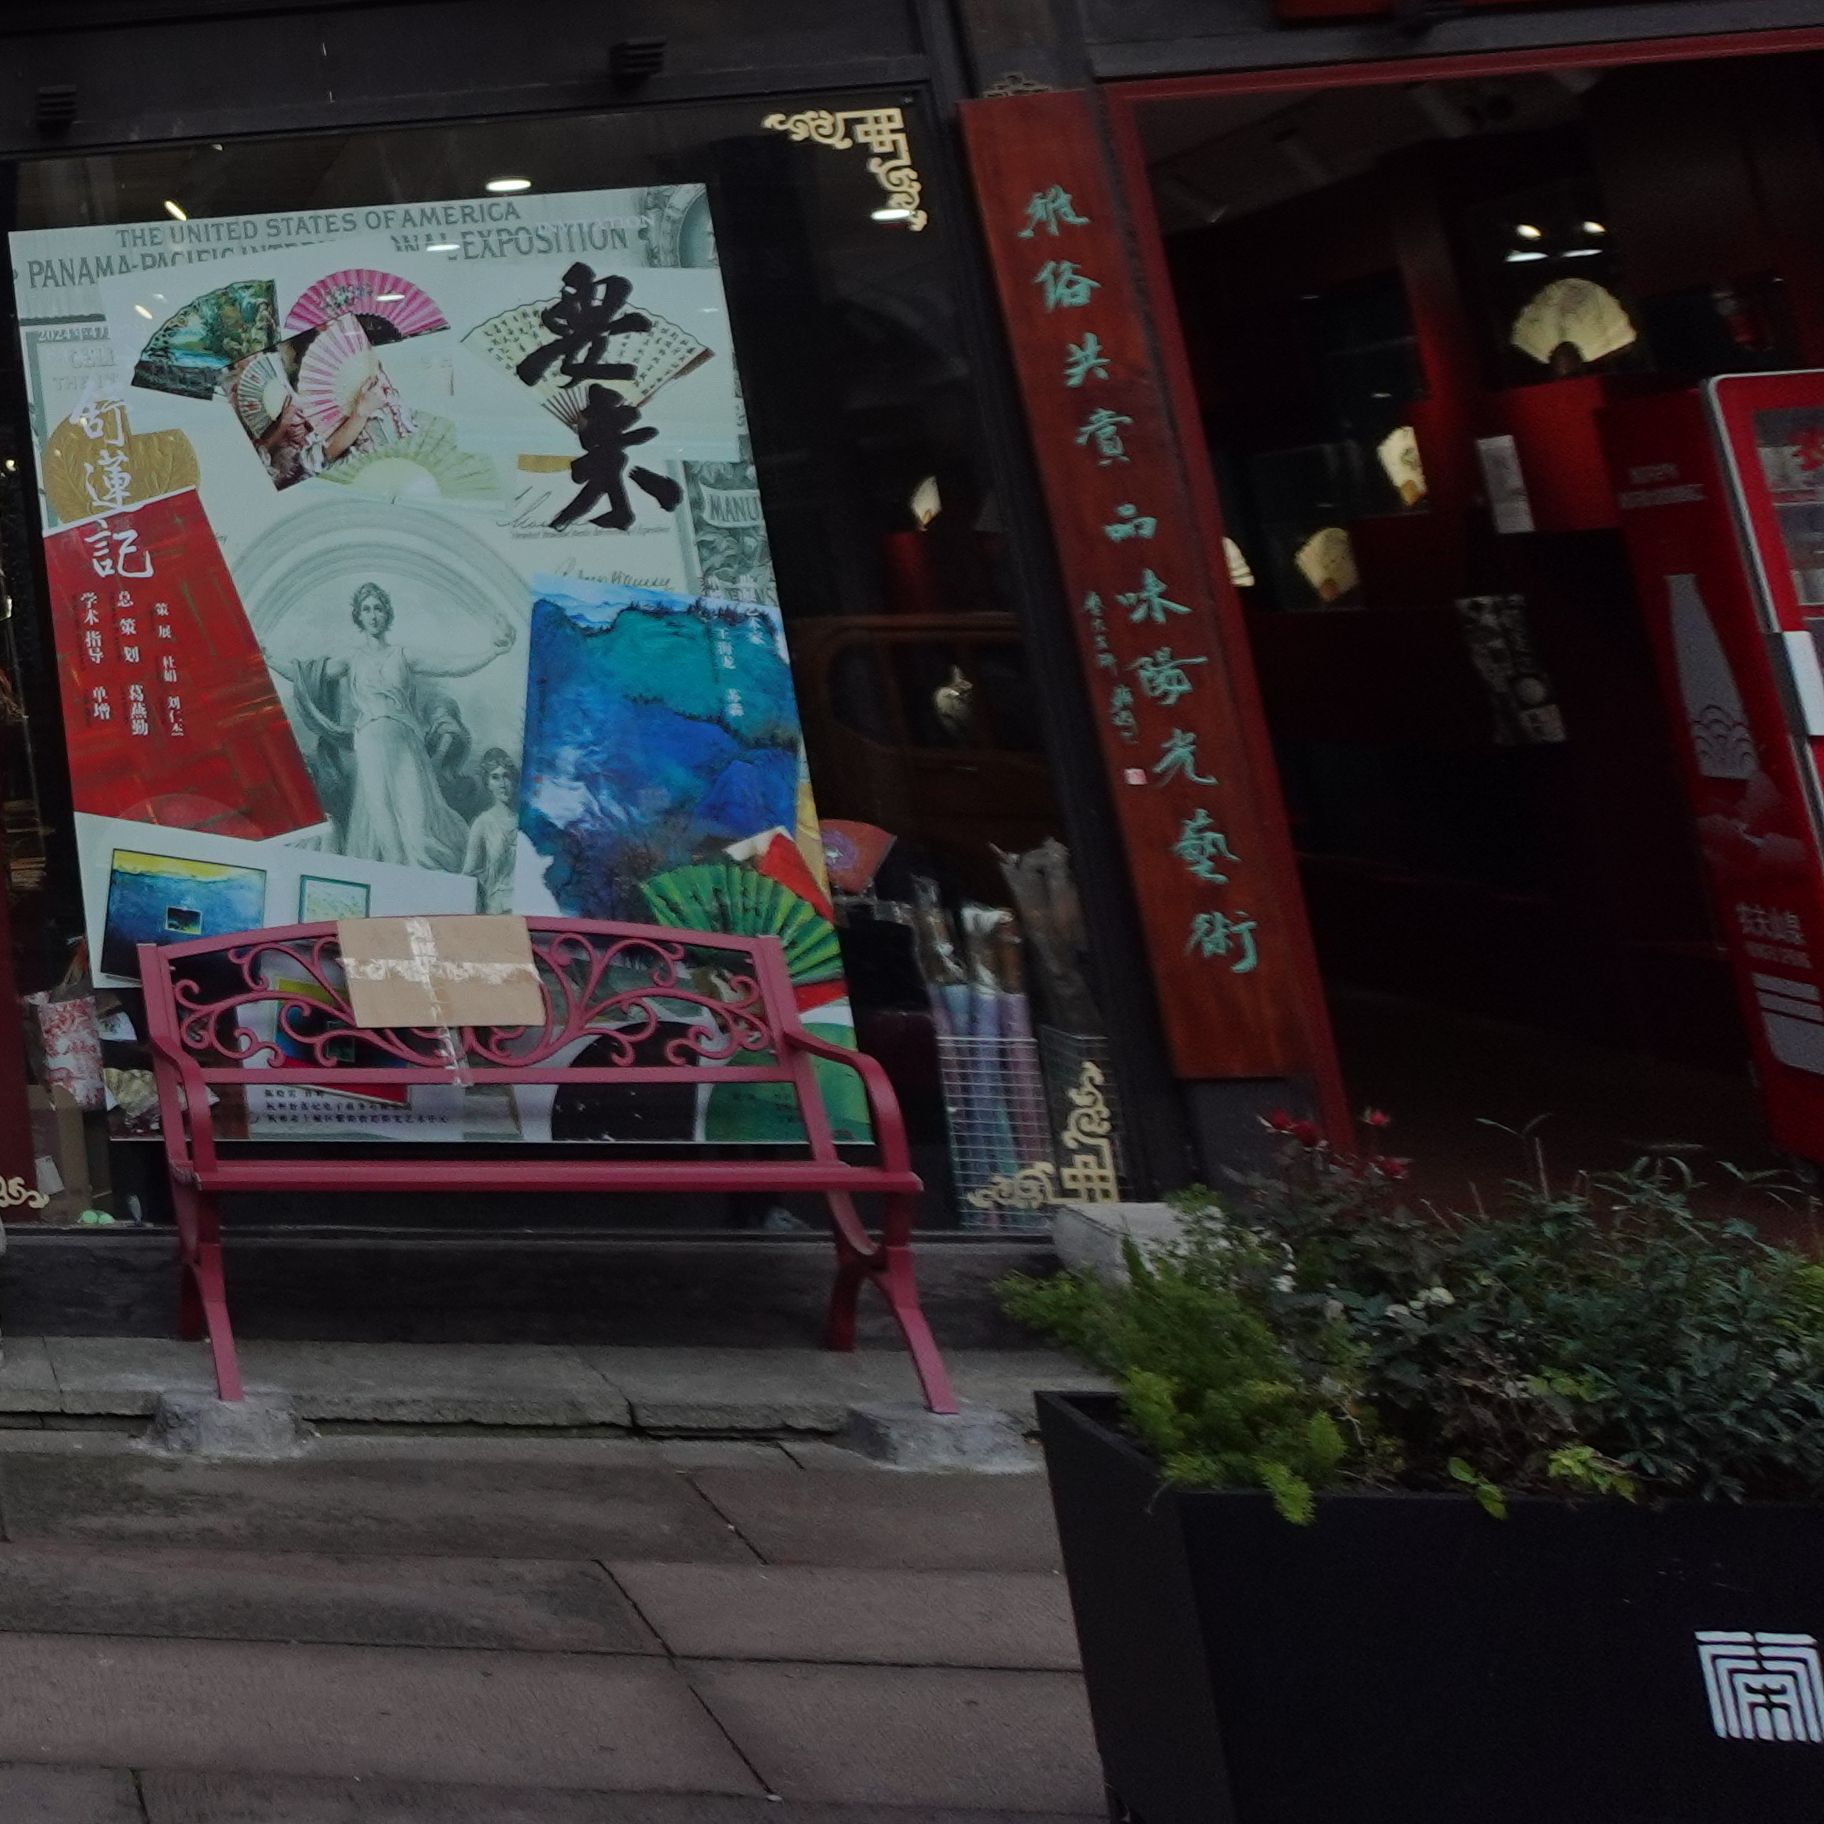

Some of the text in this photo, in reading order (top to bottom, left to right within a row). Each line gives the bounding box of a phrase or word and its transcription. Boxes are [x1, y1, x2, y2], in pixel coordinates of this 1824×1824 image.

[115, 225, 164, 249] THE
[169, 215, 259, 245] UNITED
[266, 209, 358, 239] STATES
[365, 208, 395, 231] OF
[401, 200, 522, 229] AMERICA
[462, 222, 629, 261] EXPOSITION
[79, 591, 104, 664] 学术指导
[116, 590, 140, 664] 总策划
[154, 602, 172, 639] 策展
